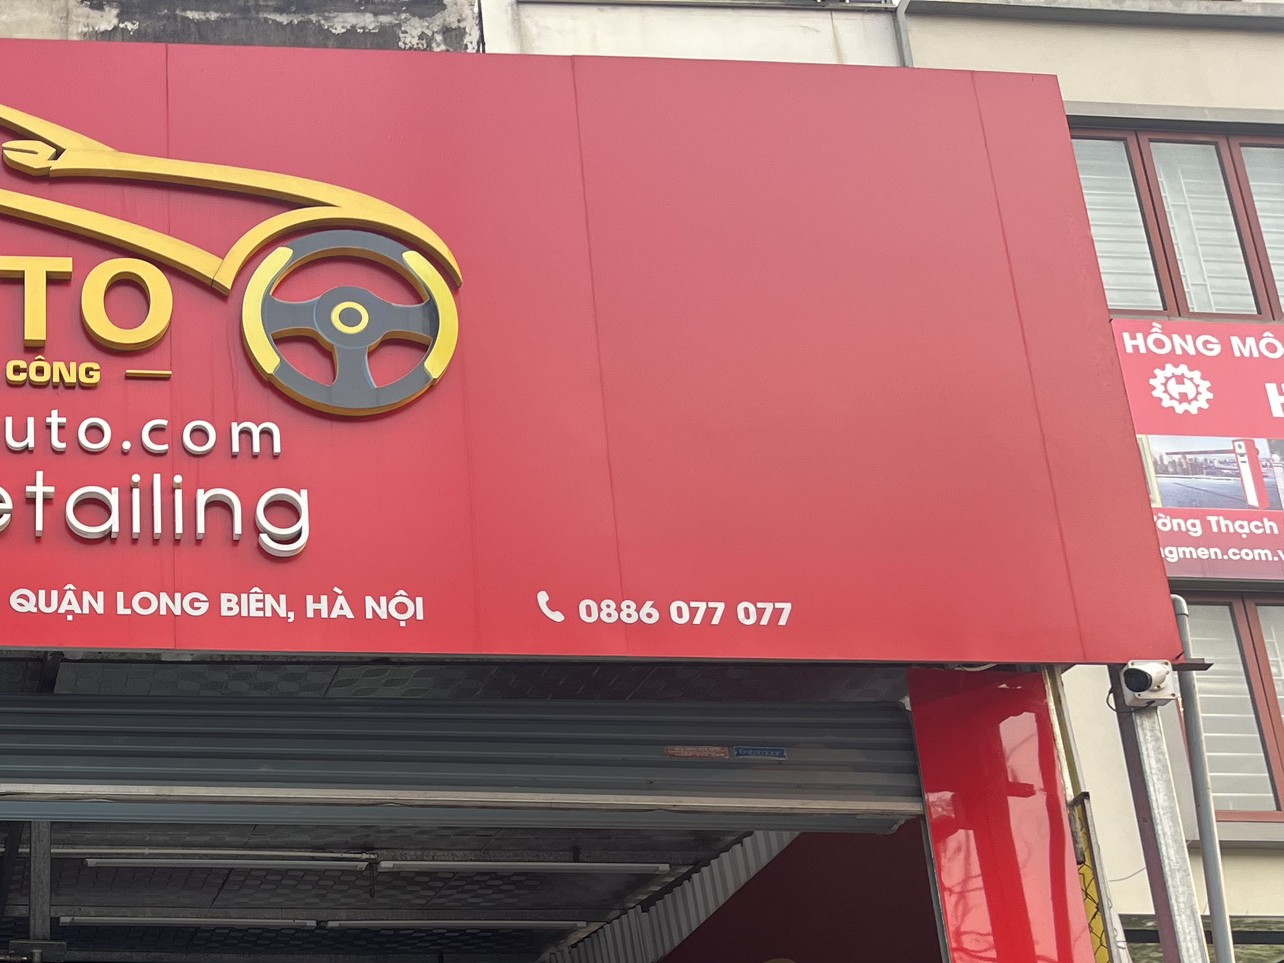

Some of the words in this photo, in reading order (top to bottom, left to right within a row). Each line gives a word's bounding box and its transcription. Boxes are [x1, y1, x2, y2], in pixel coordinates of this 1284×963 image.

[1122, 322, 1222, 357] HỒNG
[5, 355, 101, 388] CÔNG
[1206, 515, 1279, 538] Thạch
[9, 583, 104, 621] QUẬN
[116, 591, 209, 616] LONG
[219, 586, 295, 622] BIÊN,
[305, 586, 355, 619] HÀ
[364, 589, 424, 627] NỘI
[578, 599, 660, 624] 0886
[669, 600, 725, 625] 077
[736, 601, 792, 626] 077
